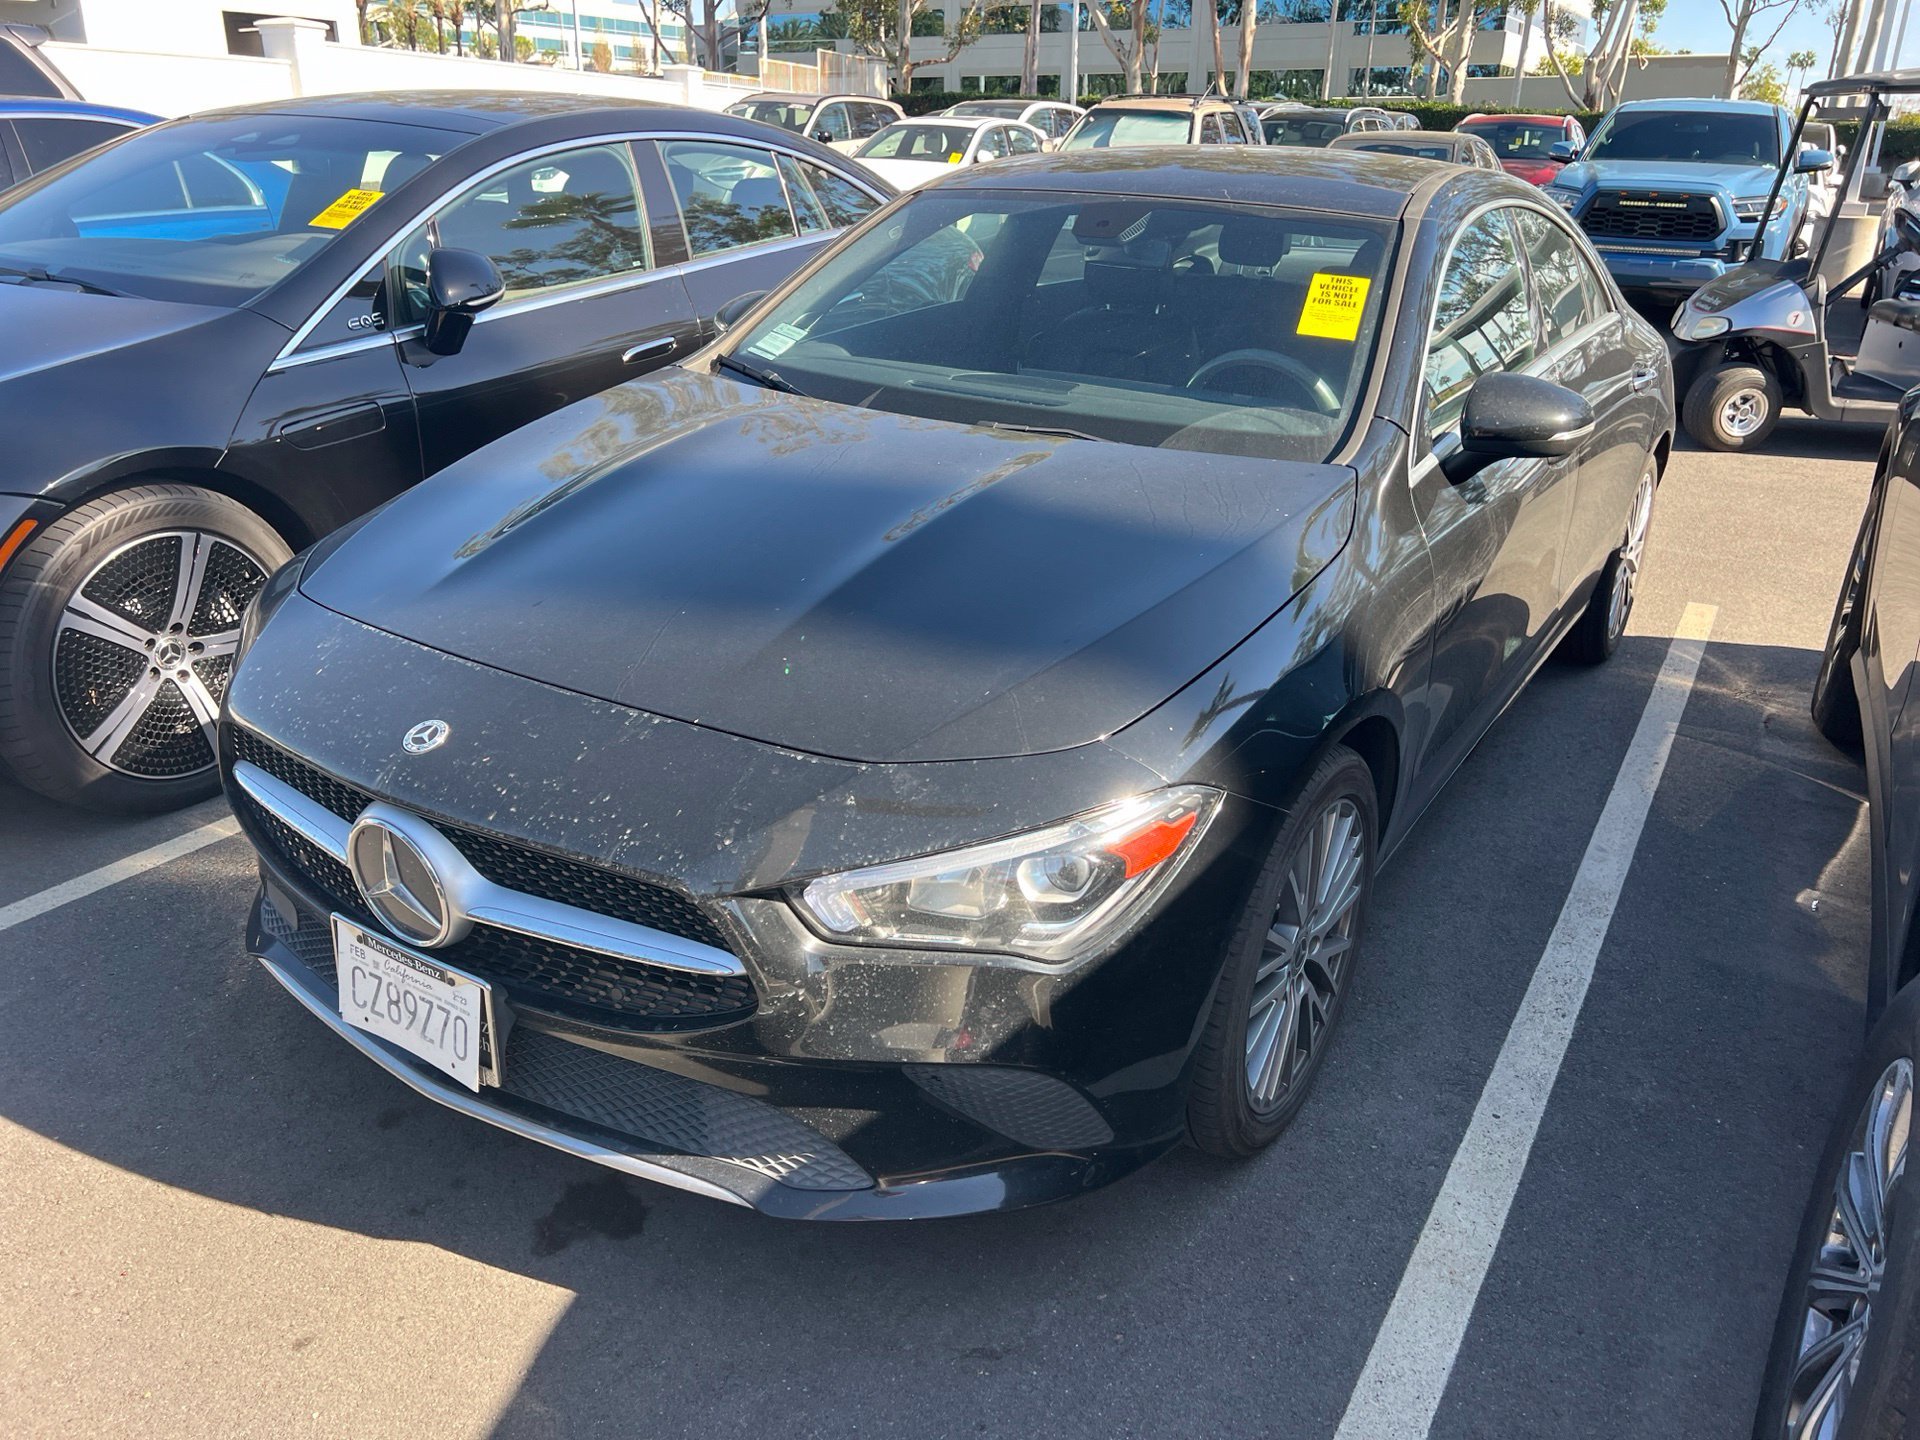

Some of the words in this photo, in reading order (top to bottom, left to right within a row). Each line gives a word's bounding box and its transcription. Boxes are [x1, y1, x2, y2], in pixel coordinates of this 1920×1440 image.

[1330, 276, 1353, 286] THIS
[1319, 283, 1360, 294] VEHICLE
[1320, 290, 1331, 298] IS
[1333, 291, 1354, 301] NOT
[1312, 297, 1332, 306] FOR
[1334, 299, 1358, 309] SALE
[347, 311, 385, 330] EQS
[1792, 313, 1800, 325] 1
[349, 943, 367, 960] FEB
[367, 936, 441, 980] Mercedes-Benz
[383, 958, 434, 991] California
[351, 965, 468, 1062] CZ89Z70
